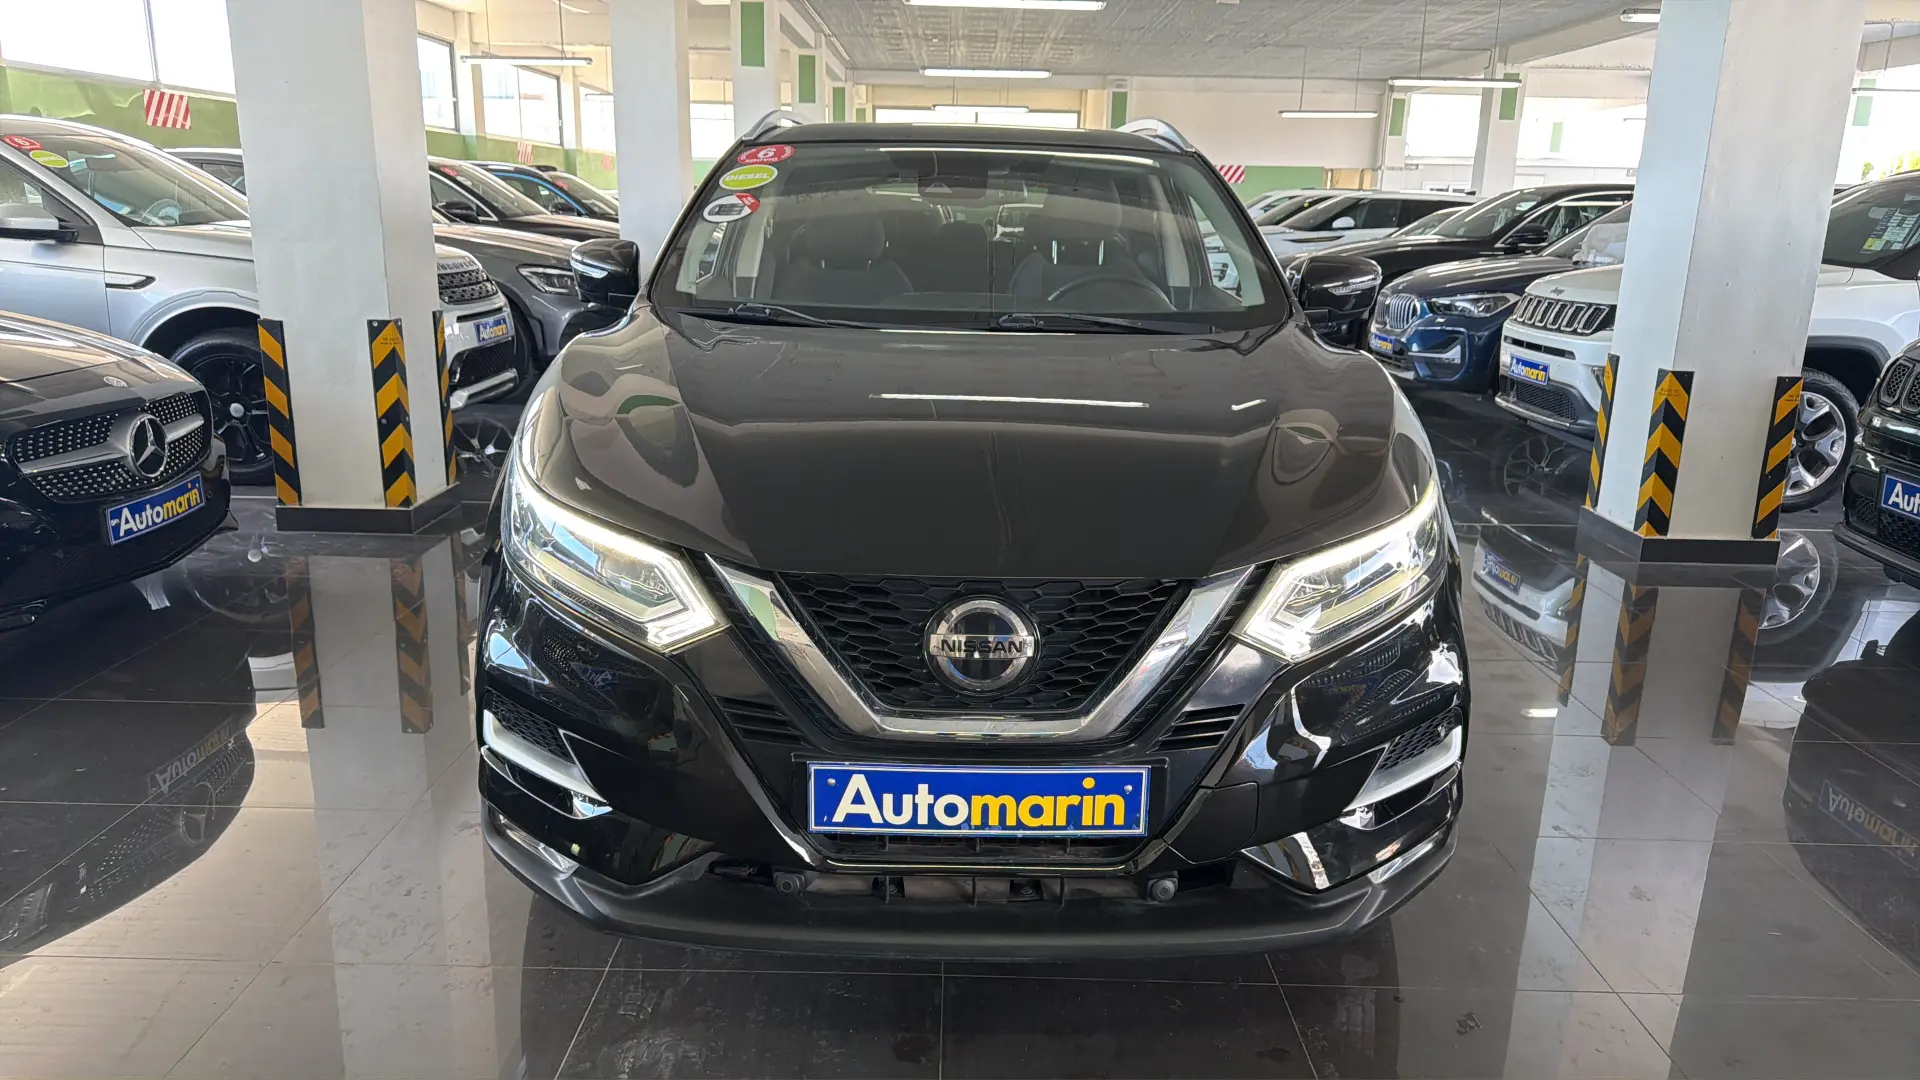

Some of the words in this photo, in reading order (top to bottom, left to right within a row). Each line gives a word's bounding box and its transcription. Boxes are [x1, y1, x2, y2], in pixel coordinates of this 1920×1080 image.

[757, 148, 777, 159] 6
[724, 172, 769, 181] DIESEL
[1510, 358, 1546, 381] Automarin
[119, 483, 201, 537] Automarin
[940, 639, 1023, 654] NISSAN
[831, 774, 1125, 826] Automarin
